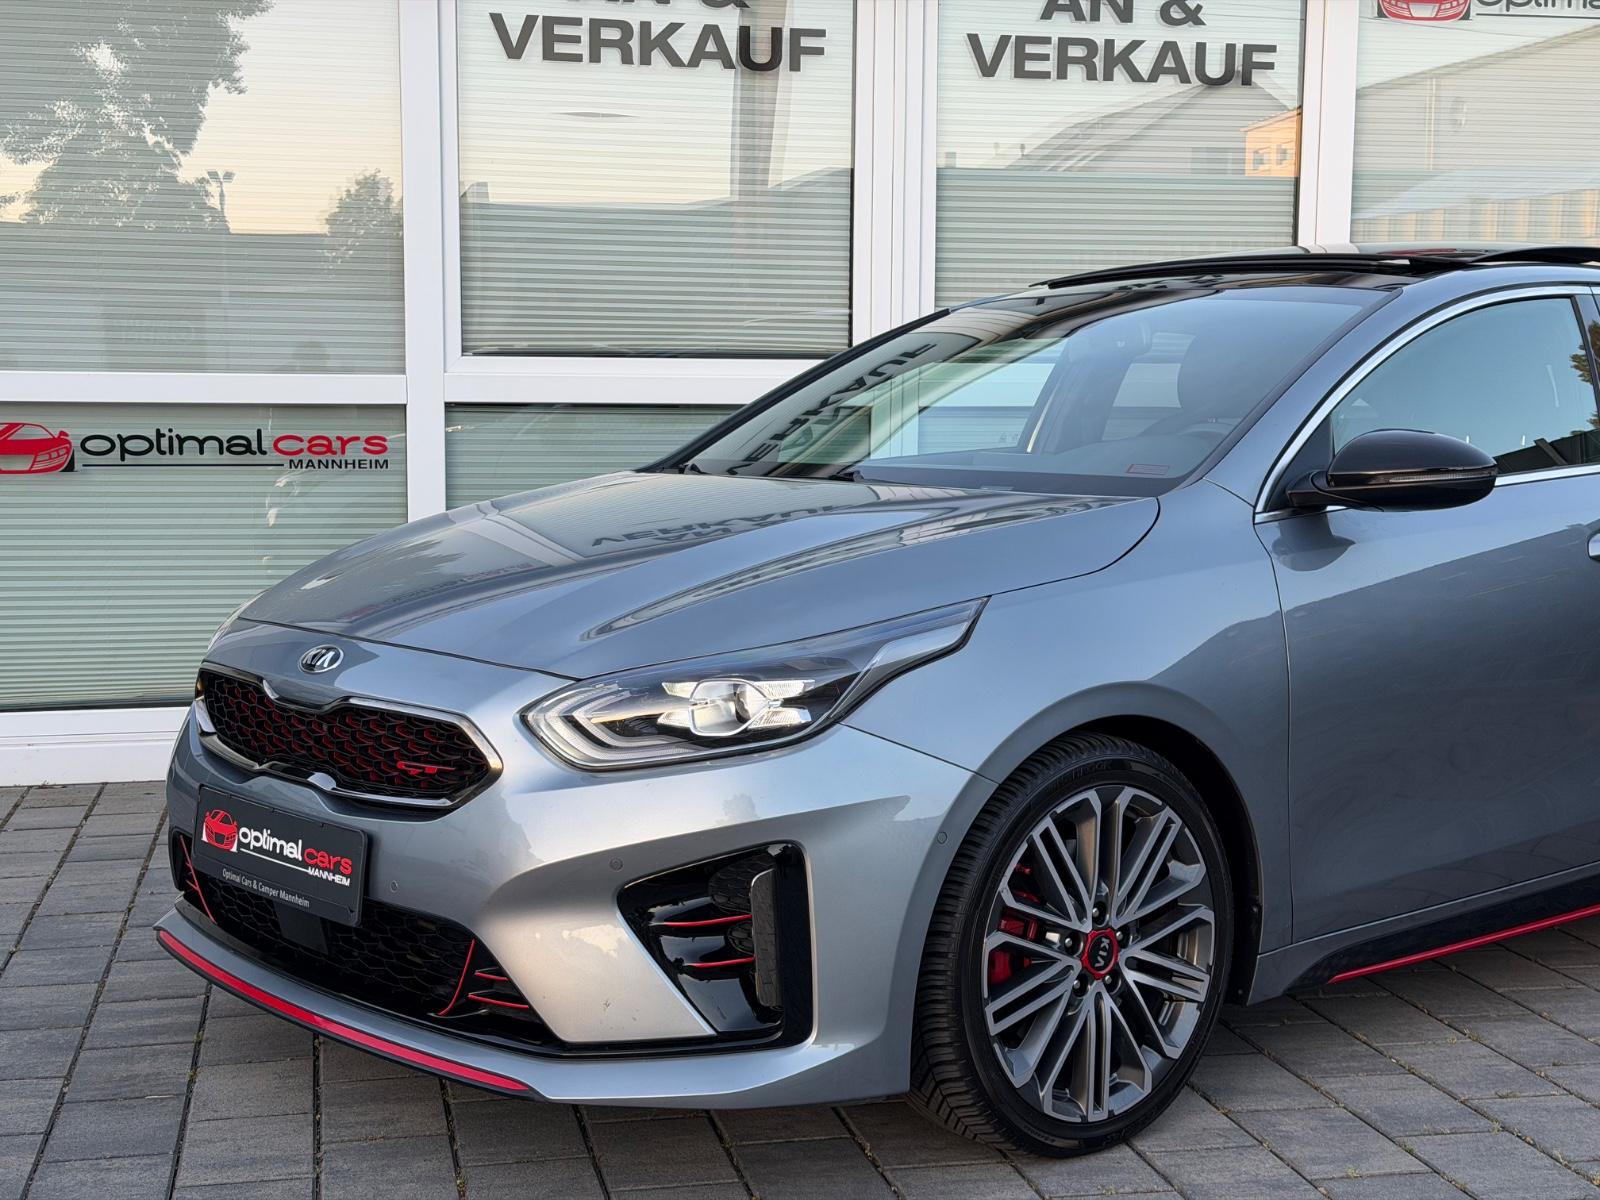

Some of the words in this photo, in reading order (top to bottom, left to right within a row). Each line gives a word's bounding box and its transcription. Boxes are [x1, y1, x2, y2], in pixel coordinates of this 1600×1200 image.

[489, 12, 827, 72] VERKAUF
[966, 33, 1277, 87] VERKAUF
[80, 428, 267, 461] optimal
[273, 434, 389, 456] cars
[288, 459, 389, 469] MANNHEIM
[238, 826, 303, 861] optimal
[303, 847, 353, 875] cars
[222, 867, 242, 882] Optimal
[241, 874, 253, 888] Cars
[252, 879, 258, 890] &
[258, 881, 279, 898] Camper
[279, 885, 310, 908] Mannheim
[308, 865, 351, 887] MANNHEIM
[1094, 937, 1111, 968] KIA
